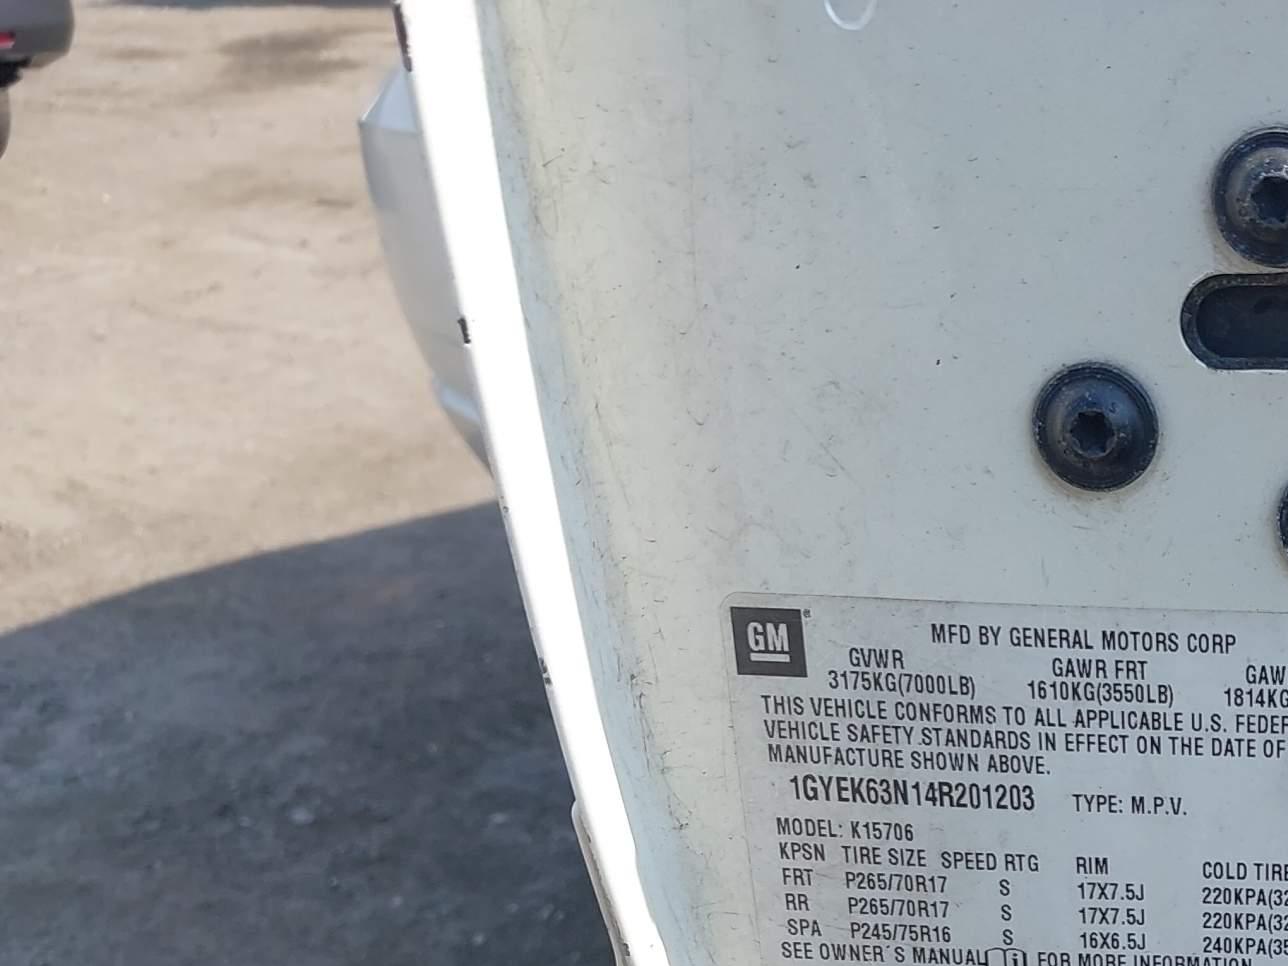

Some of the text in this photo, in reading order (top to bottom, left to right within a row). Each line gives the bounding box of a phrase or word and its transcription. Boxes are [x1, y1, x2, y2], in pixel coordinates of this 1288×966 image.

[747, 622, 790, 652] GM
[931, 623, 1237, 655] MFD BY GENERAL MOTORS CORP
[849, 647, 905, 669] GVWR
[1052, 658, 1148, 680] GAWR FRT
[828, 670, 976, 700] 3175KG(7000LB)
[1027, 680, 1174, 708] 1610KG(3550LB)
[761, 694, 804, 716] THIS
[810, 697, 887, 720] VEHICLE
[895, 700, 996, 724] CONFORMS
[1002, 706, 1026, 726] TO
[1035, 707, 1067, 728] ALL
[1074, 709, 1183, 732] APPLICABLE
[1191, 713, 1227, 733] U.S.
[763, 719, 1287, 759] VEHICLE SAFETY STANDARDS IN EFFECT ON THE DATE OF
[767, 743, 1051, 775] MANUFACTURE SHOWN ABOVE.
[790, 774, 1035, 810] 1GYEK63N14R201203
[1072, 794, 1187, 816] TYPE: M.P.V.
[776, 817, 914, 841] MODEL: K15706
[779, 842, 1039, 873] KPSN TIRE SIZE SPEED RTG
[1076, 856, 1109, 875] RIM
[782, 867, 813, 887] FRT
[845, 871, 947, 893] P265/70R17
[1202, 862, 1247, 881] COLD
[999, 879, 1011, 897] S
[1077, 882, 1145, 901] 17X7.5J
[785, 893, 810, 912] RR
[848, 896, 949, 919] P265/70R17
[1001, 904, 1013, 922] S
[1078, 907, 1146, 926] 17X7.5J
[787, 918, 822, 938] SPA
[851, 921, 951, 944] P245/75R16
[1002, 929, 1014, 947] S
[1079, 932, 1146, 951] 16X6.5J
[781, 942, 813, 961] SEE
[912, 946, 986, 966] MANUAL
